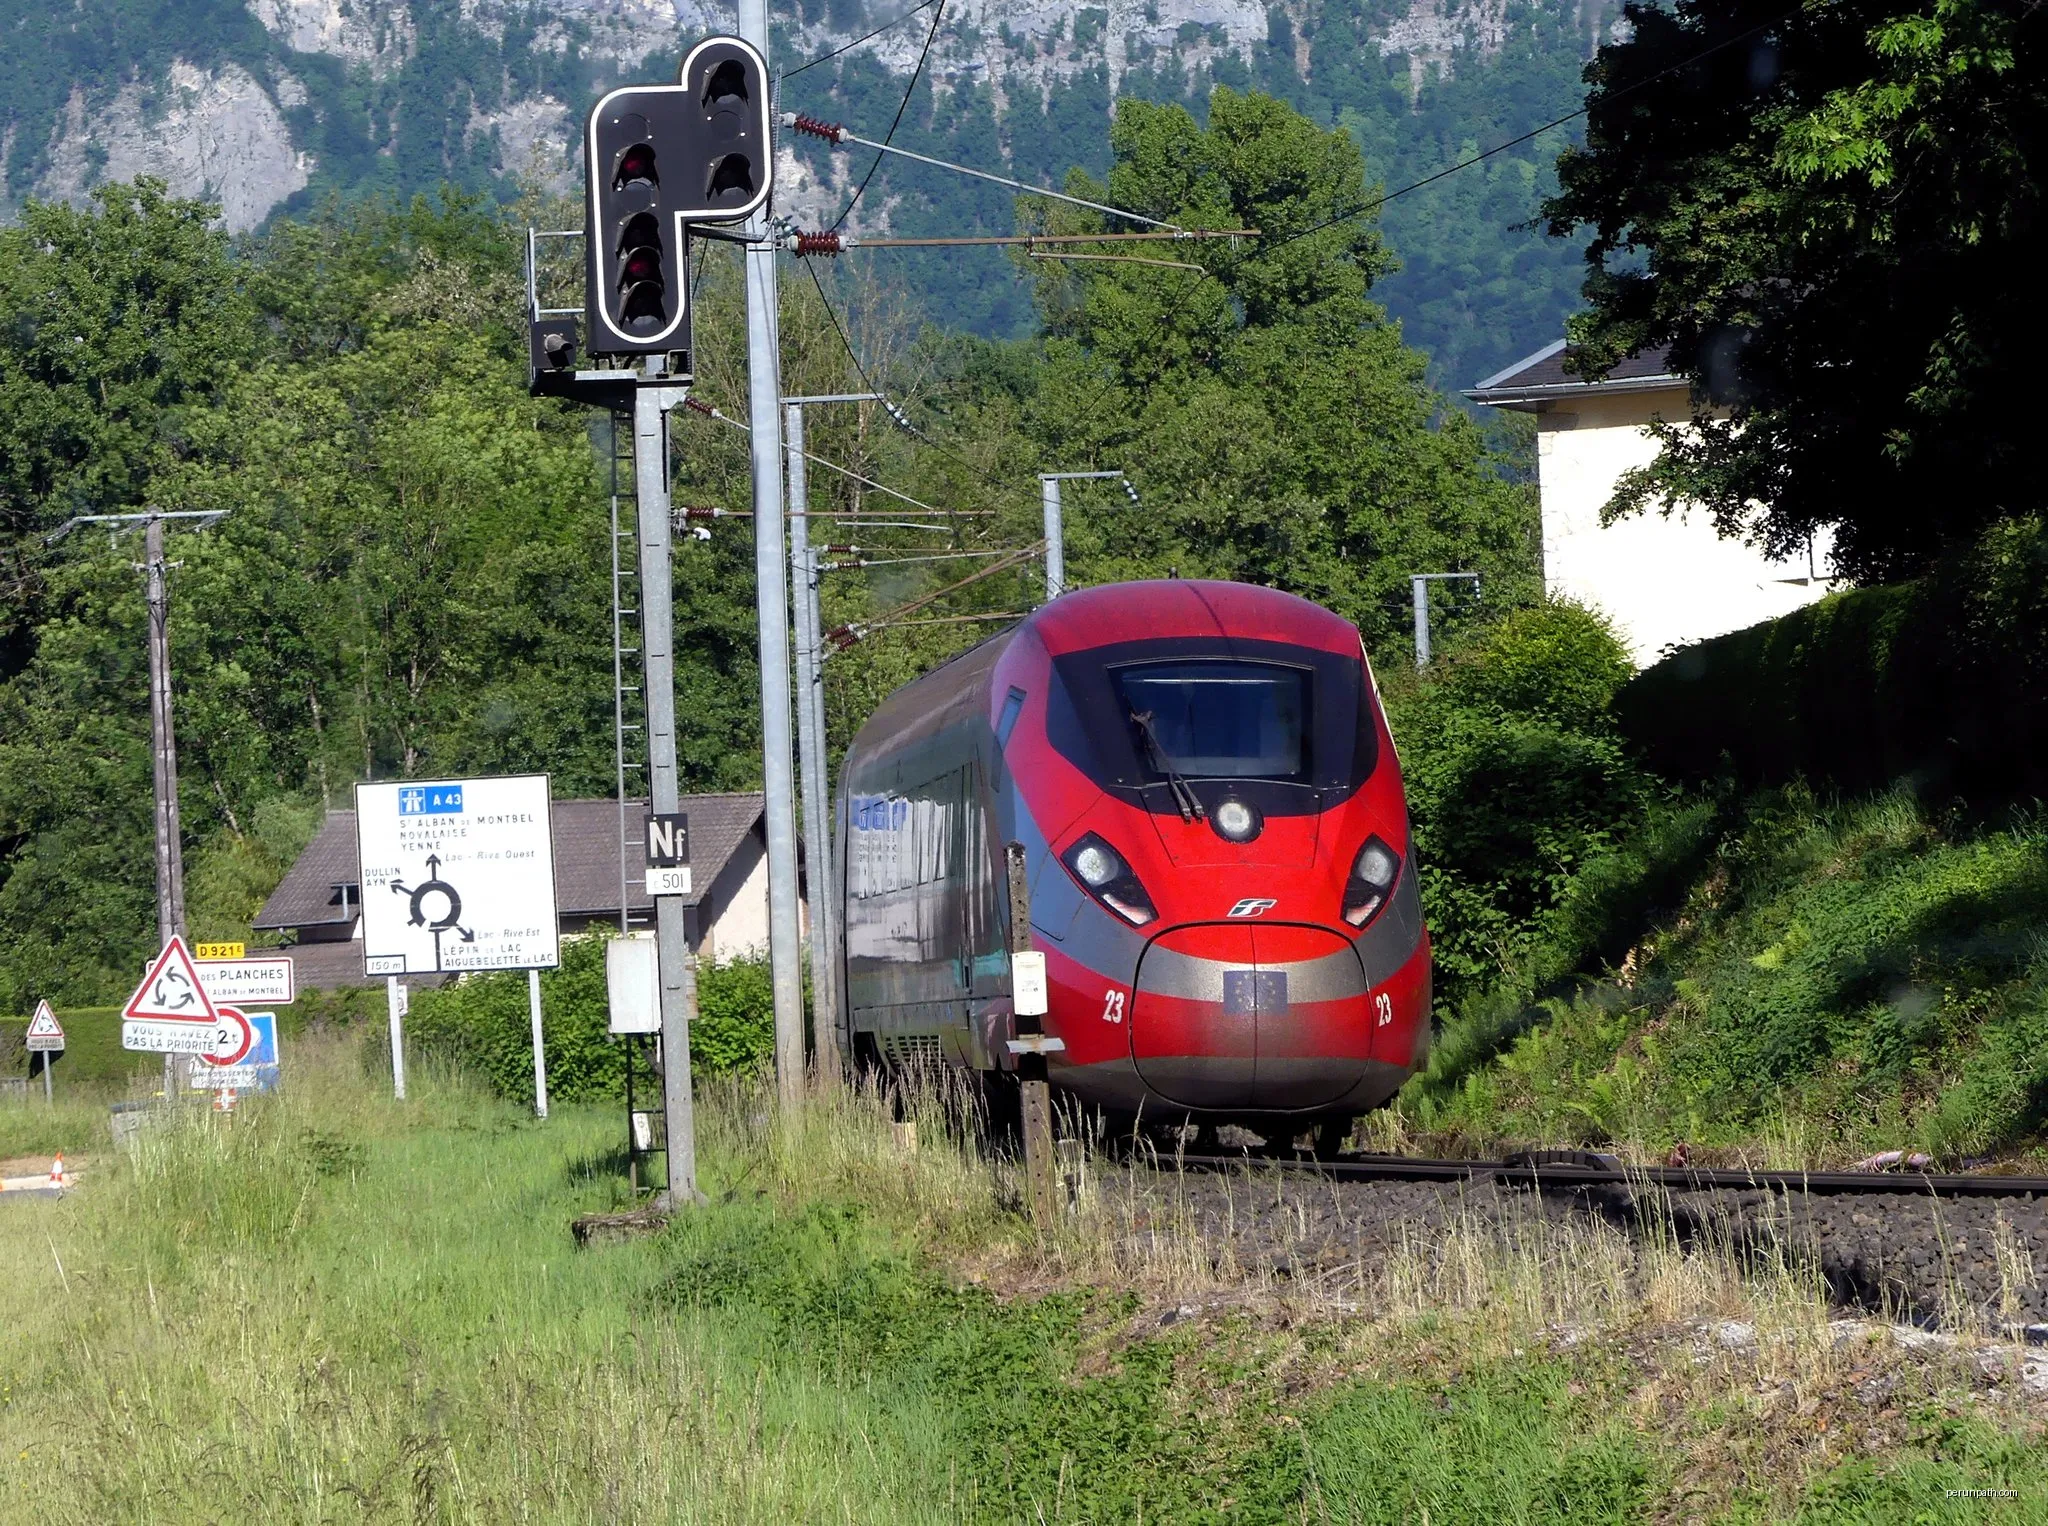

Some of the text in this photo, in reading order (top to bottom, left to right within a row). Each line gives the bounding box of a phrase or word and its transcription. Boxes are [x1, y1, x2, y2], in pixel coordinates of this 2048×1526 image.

[432, 793, 461, 806] A 43
[417, 817, 455, 827] ALBAN
[477, 814, 534, 824] MONTBEL
[400, 828, 467, 840] NOVALAISE
[649, 821, 686, 858] Nf
[401, 841, 441, 851] YENNE
[445, 853, 463, 862] Lac
[505, 850, 535, 859] Ouest
[364, 867, 401, 877] DULLIN
[366, 878, 386, 887] AYN
[478, 931, 495, 939] Lac
[503, 929, 523, 938] Rive
[526, 928, 540, 937] Est
[501, 944, 521, 953] LAC
[371, 961, 389, 970] 150
[445, 955, 521, 967] AIGUEBELETTE
[534, 953, 553, 963] LAC
[220, 969, 284, 980] PLANCHES
[248, 987, 284, 995] MONTBEL
[1102, 989, 1125, 1024] 23
[1375, 992, 1392, 1027] 23
[126, 1036, 215, 1051] PAS LA PRIORITÉ
